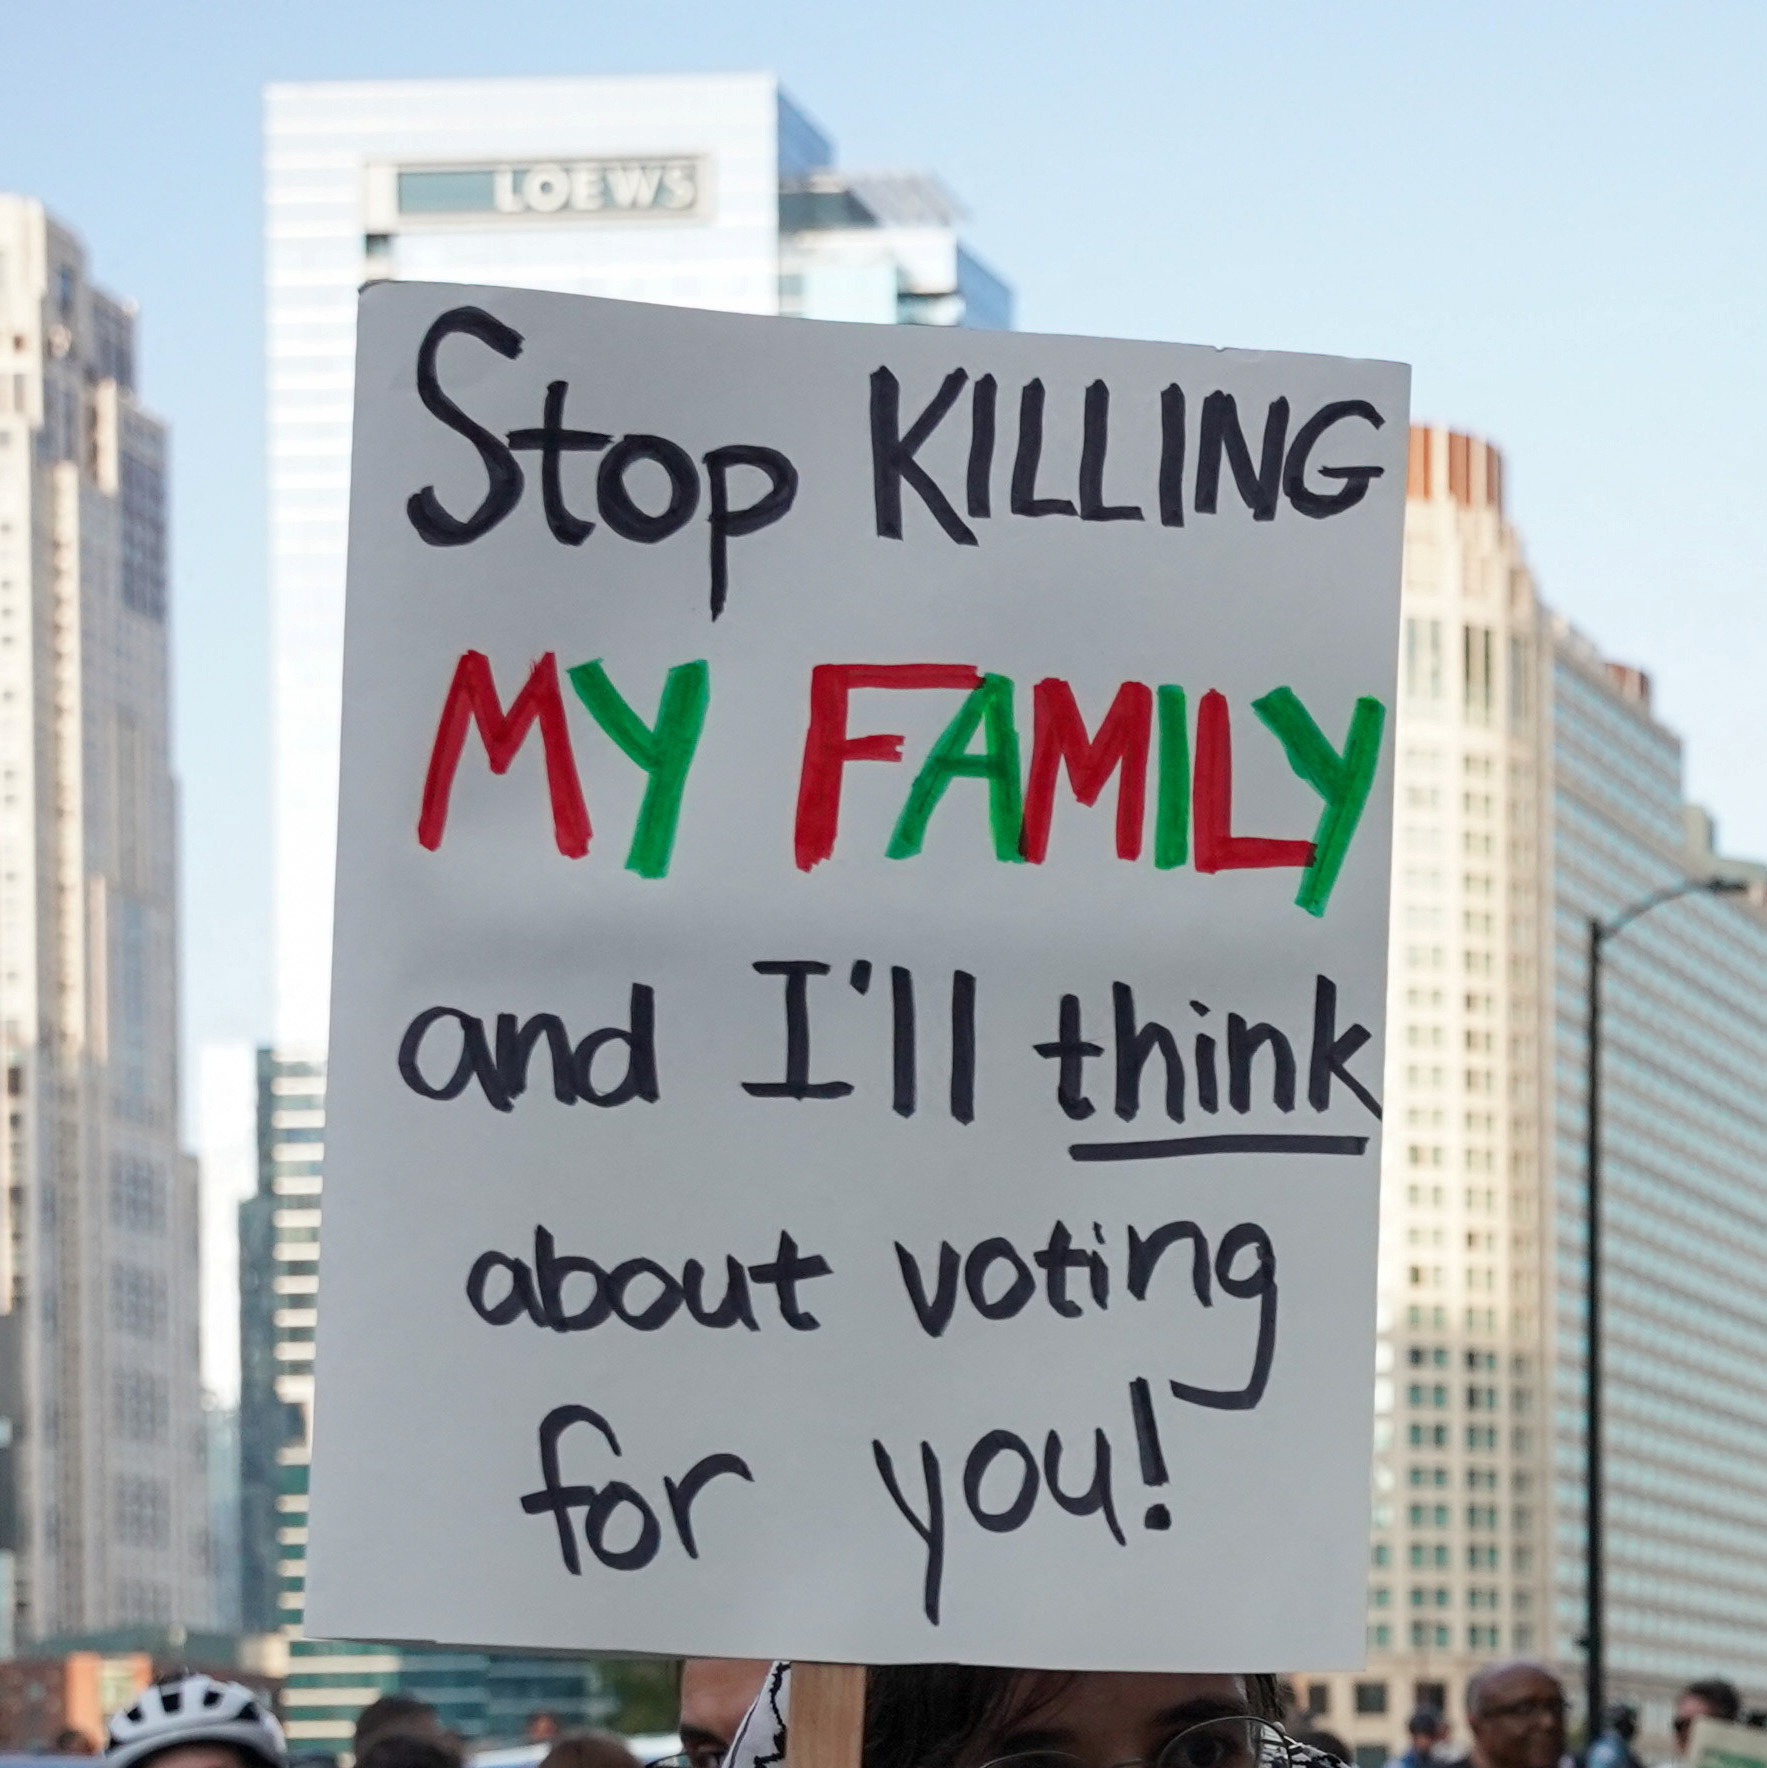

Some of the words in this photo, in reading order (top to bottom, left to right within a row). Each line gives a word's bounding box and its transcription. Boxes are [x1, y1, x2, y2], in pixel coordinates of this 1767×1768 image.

[494, 162, 697, 214] LOEWS
[408, 306, 798, 621] Stop
[869, 362, 1384, 546] KILLING
[417, 650, 710, 879] MY
[795, 662, 1384, 918] FAMILY
[398, 982, 660, 1114] and
[741, 960, 975, 1124] I'll
[1033, 975, 1383, 1122] think
[466, 1224, 832, 1331] about
[894, 1221, 1277, 1410] voting
[521, 1404, 754, 1575] for
[873, 1377, 1172, 1626] you!
